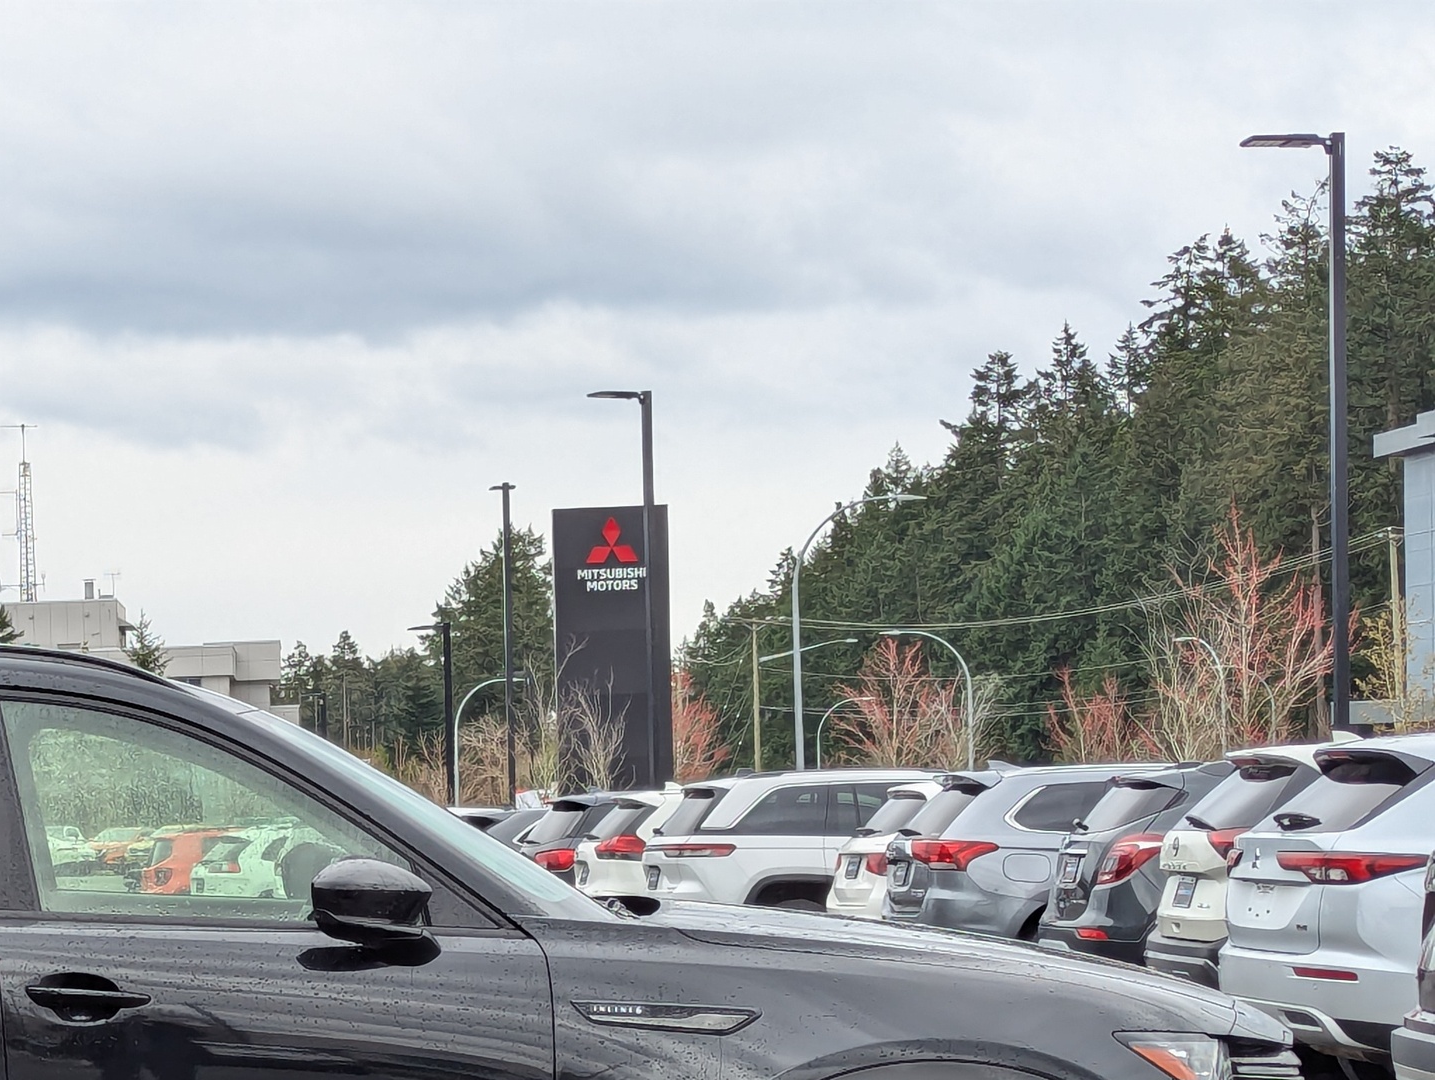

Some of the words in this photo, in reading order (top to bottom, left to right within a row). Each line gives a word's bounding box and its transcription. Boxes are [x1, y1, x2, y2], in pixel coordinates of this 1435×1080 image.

[577, 566, 647, 580] MITSUBISHI
[586, 579, 639, 592] MOTORS
[635, 1005, 642, 1015] 6
